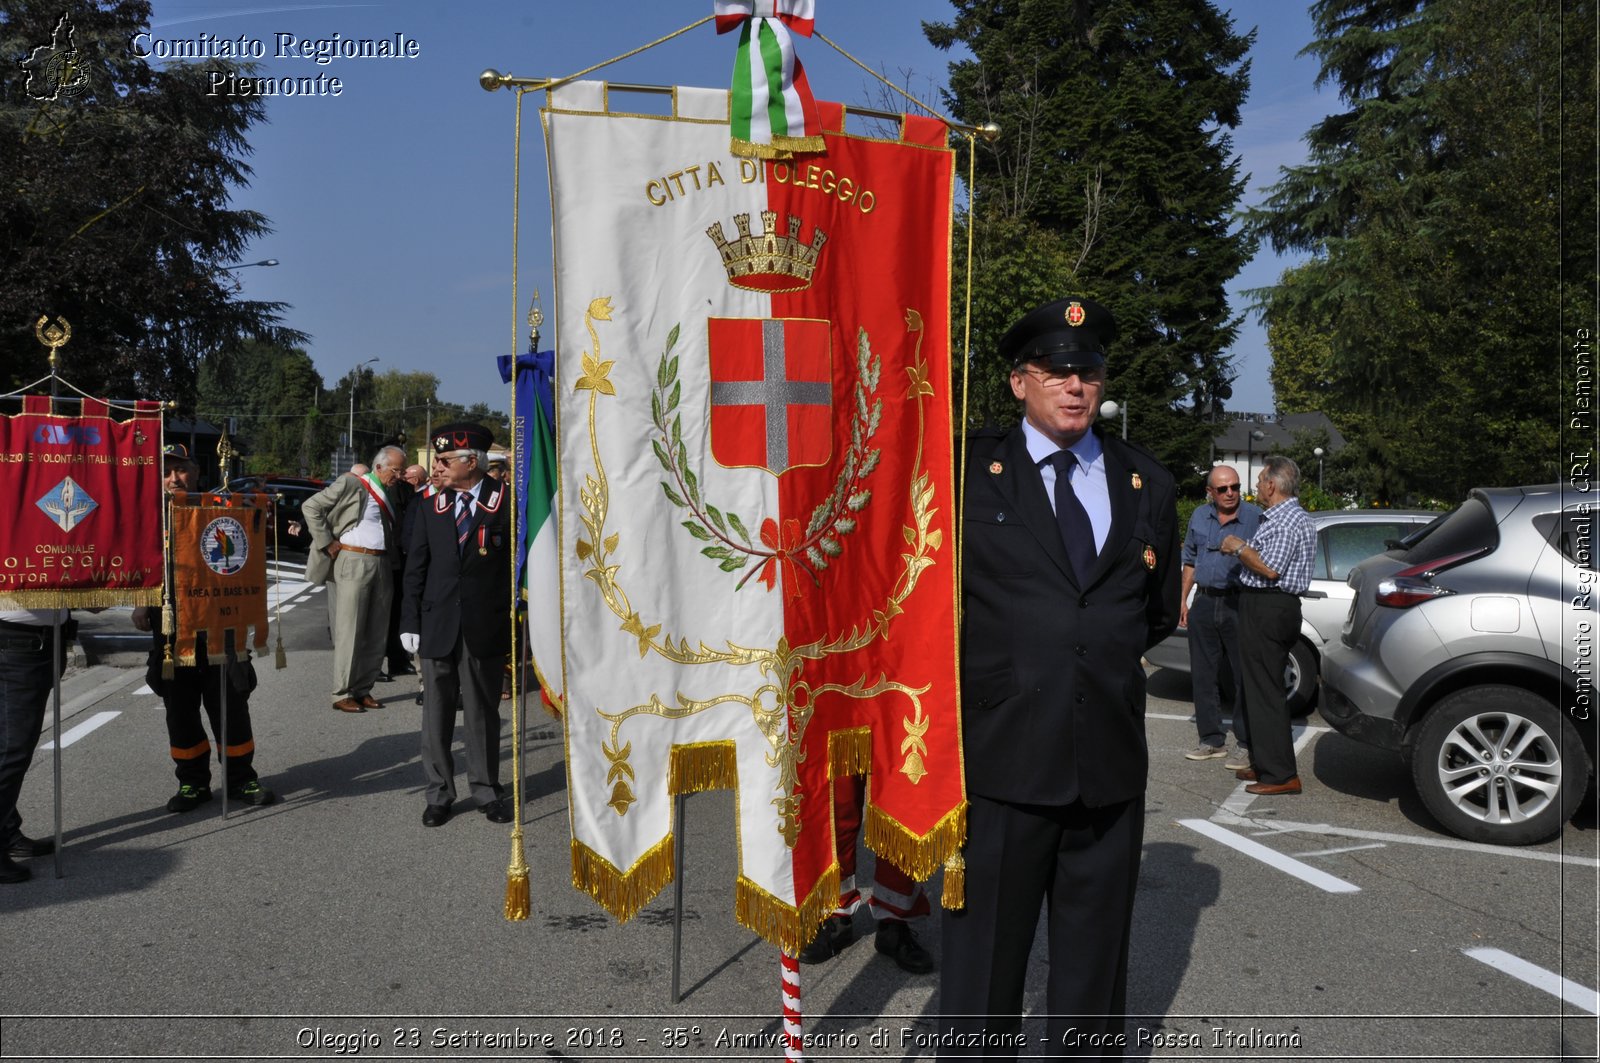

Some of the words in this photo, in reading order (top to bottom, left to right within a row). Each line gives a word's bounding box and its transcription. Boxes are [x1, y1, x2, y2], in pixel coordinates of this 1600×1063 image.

[739, 159, 766, 184] DI
[773, 161, 877, 214] OLEGGIO
[33, 424, 101, 445] AVIS
[38, 453, 84, 464] VOLONTARI
[87, 454, 118, 465] ITALIANI
[122, 456, 154, 466] SANGUE
[516, 416, 525, 502] CARABINIERI
[35, 544, 95, 554] COMUNALE
[4, 556, 123, 568] OLEGGIO
[188, 588, 210, 597] AREA
[213, 588, 221, 597] DI
[224, 587, 242, 596] BASE
